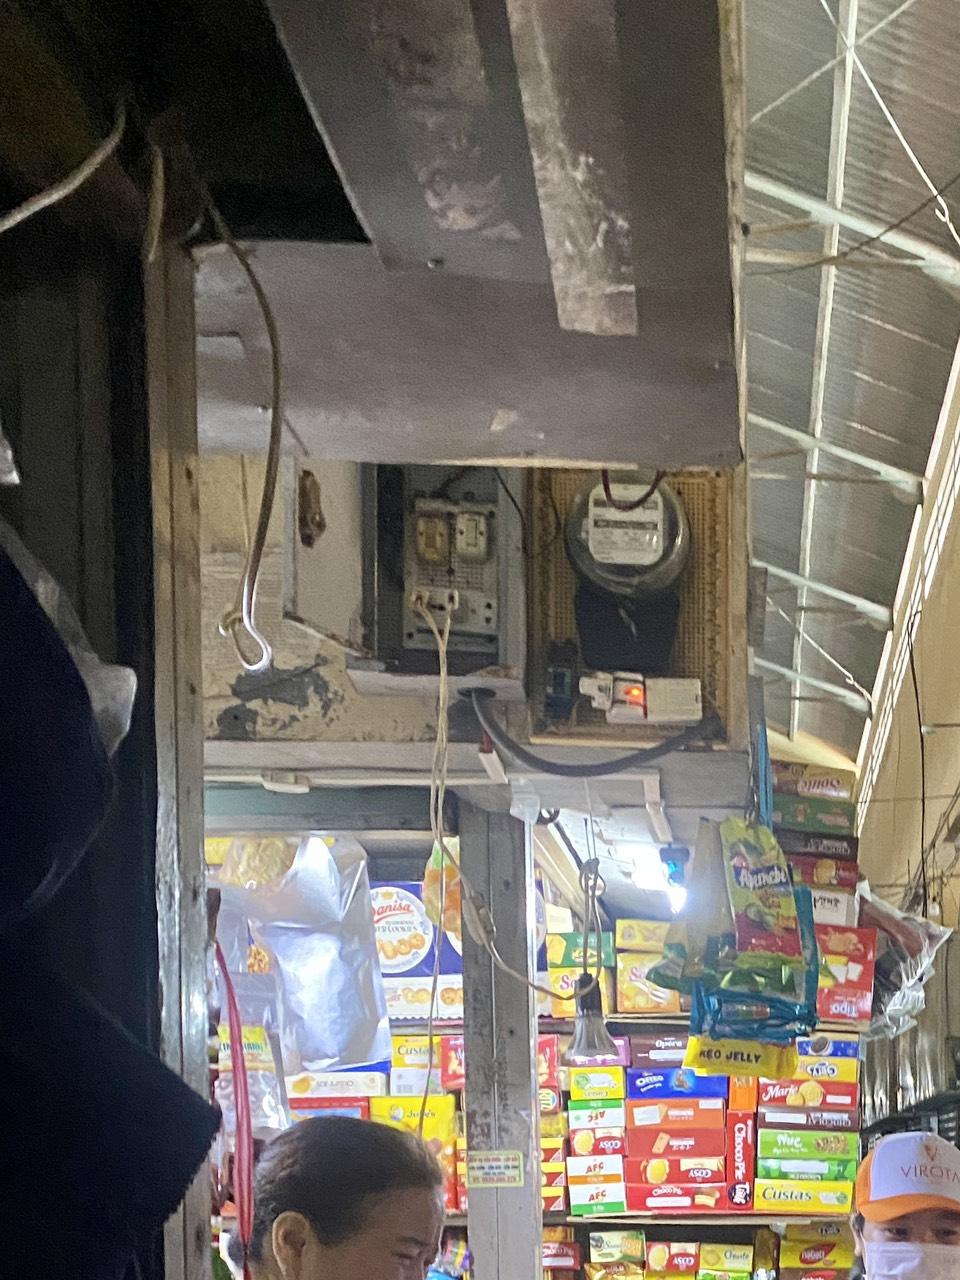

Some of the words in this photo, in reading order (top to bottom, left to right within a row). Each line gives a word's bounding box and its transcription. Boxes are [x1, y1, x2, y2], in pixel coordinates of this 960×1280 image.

[725, 1050, 762, 1064] JELLY
[587, 1110, 606, 1122] AFC
[599, 1139, 621, 1149] COSY
[585, 1162, 604, 1174] AFC
[688, 1168, 712, 1179] COSY
[900, 1164, 960, 1184] VIROTA
[588, 1190, 607, 1202] AFC
[762, 1186, 812, 1201] Custas
[801, 1249, 825, 1260] nabati
[672, 1256, 695, 1266] COSY
